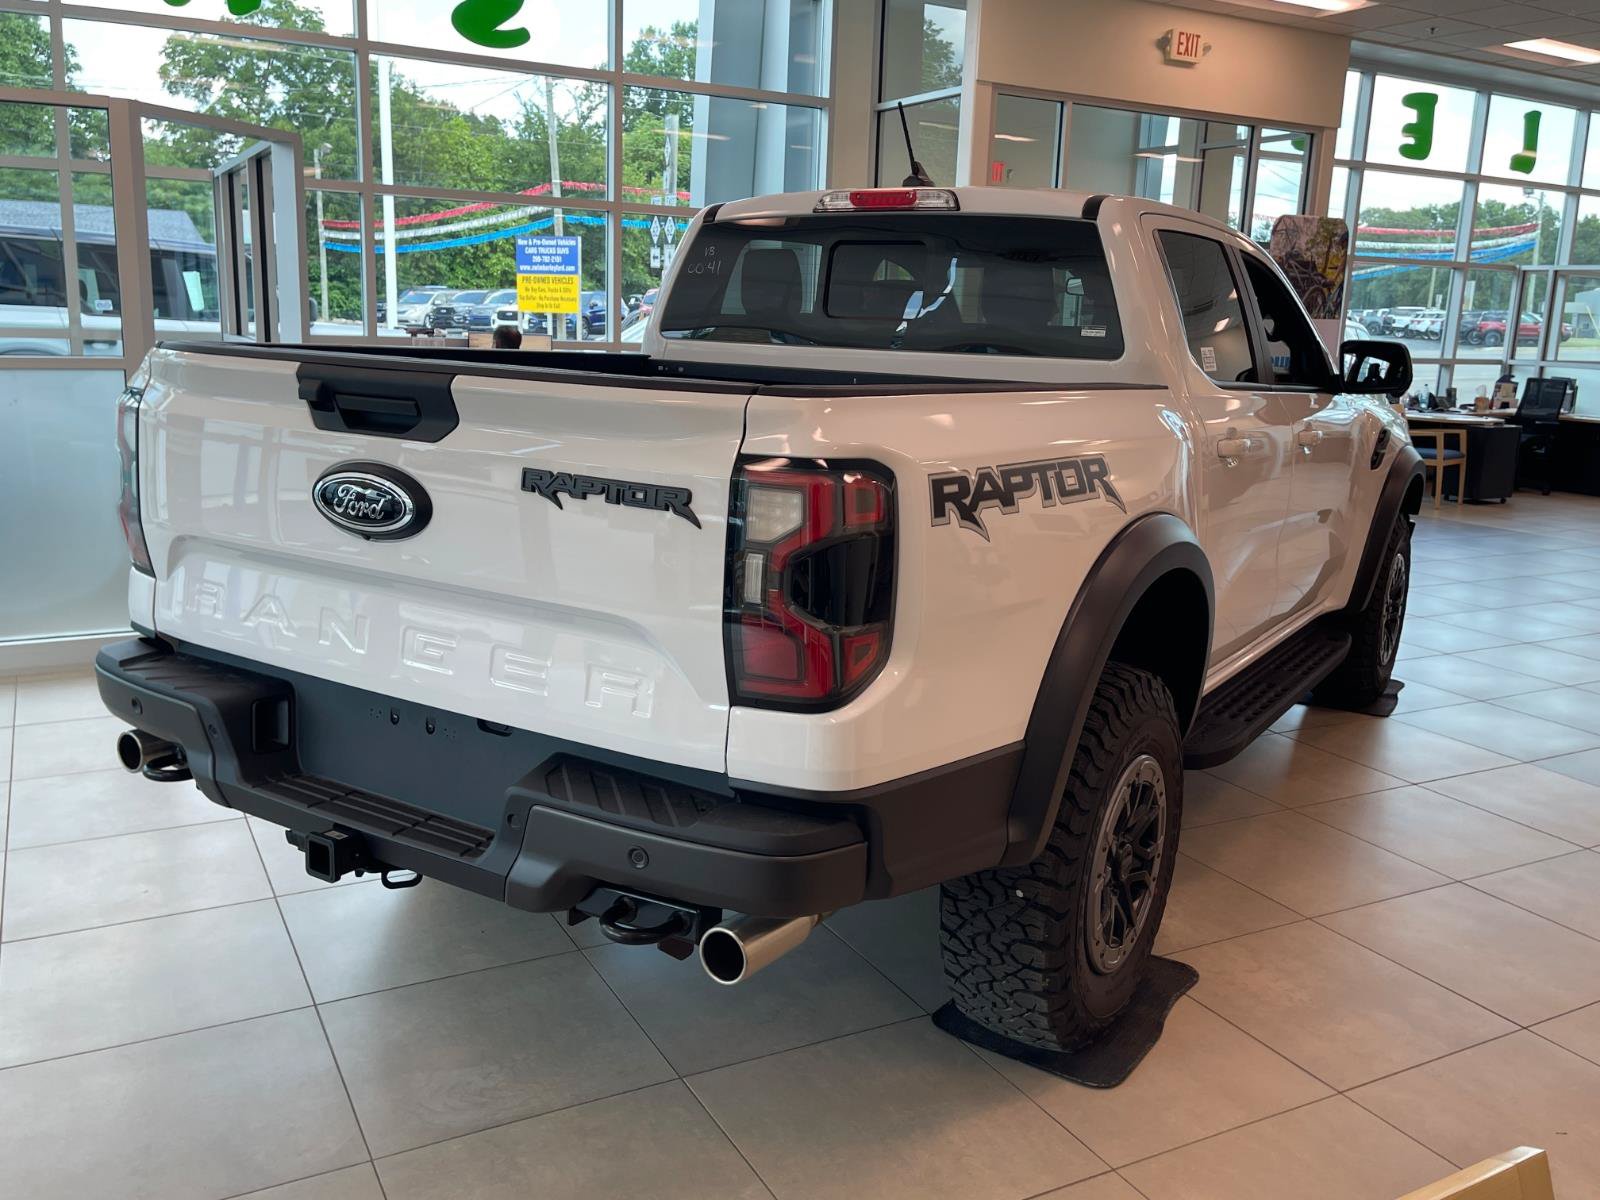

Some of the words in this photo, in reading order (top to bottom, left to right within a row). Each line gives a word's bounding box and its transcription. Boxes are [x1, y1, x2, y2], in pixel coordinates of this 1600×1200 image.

[1177, 31, 1201, 58] EXIT
[522, 276, 551, 284] PRE-OWNED
[552, 276, 574, 285] VEHICLES
[521, 466, 702, 530] RAPTOR
[927, 453, 1127, 543] RAPTOR
[186, 577, 655, 718] RANGER
